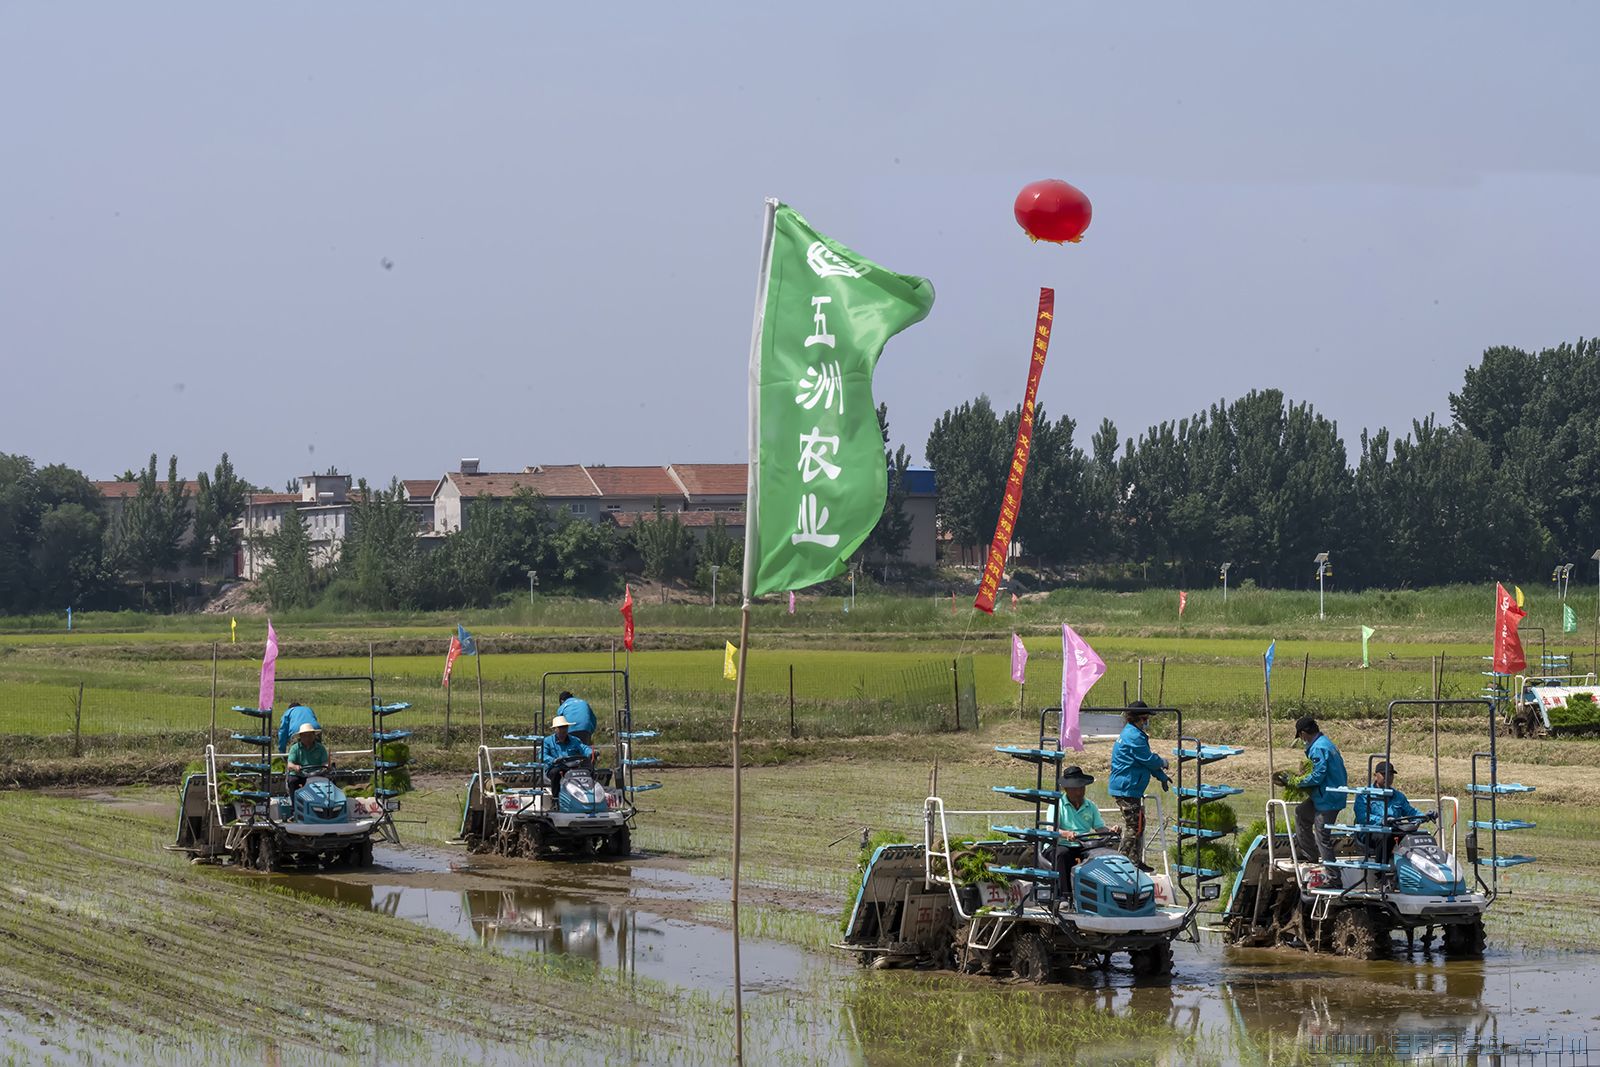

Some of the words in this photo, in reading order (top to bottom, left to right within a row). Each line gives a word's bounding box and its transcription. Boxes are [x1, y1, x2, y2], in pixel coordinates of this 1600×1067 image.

[1034, 311, 1053, 365] 产业振兴
[791, 295, 845, 549] 五洲农业
[354, 802, 382, 815] 农业
